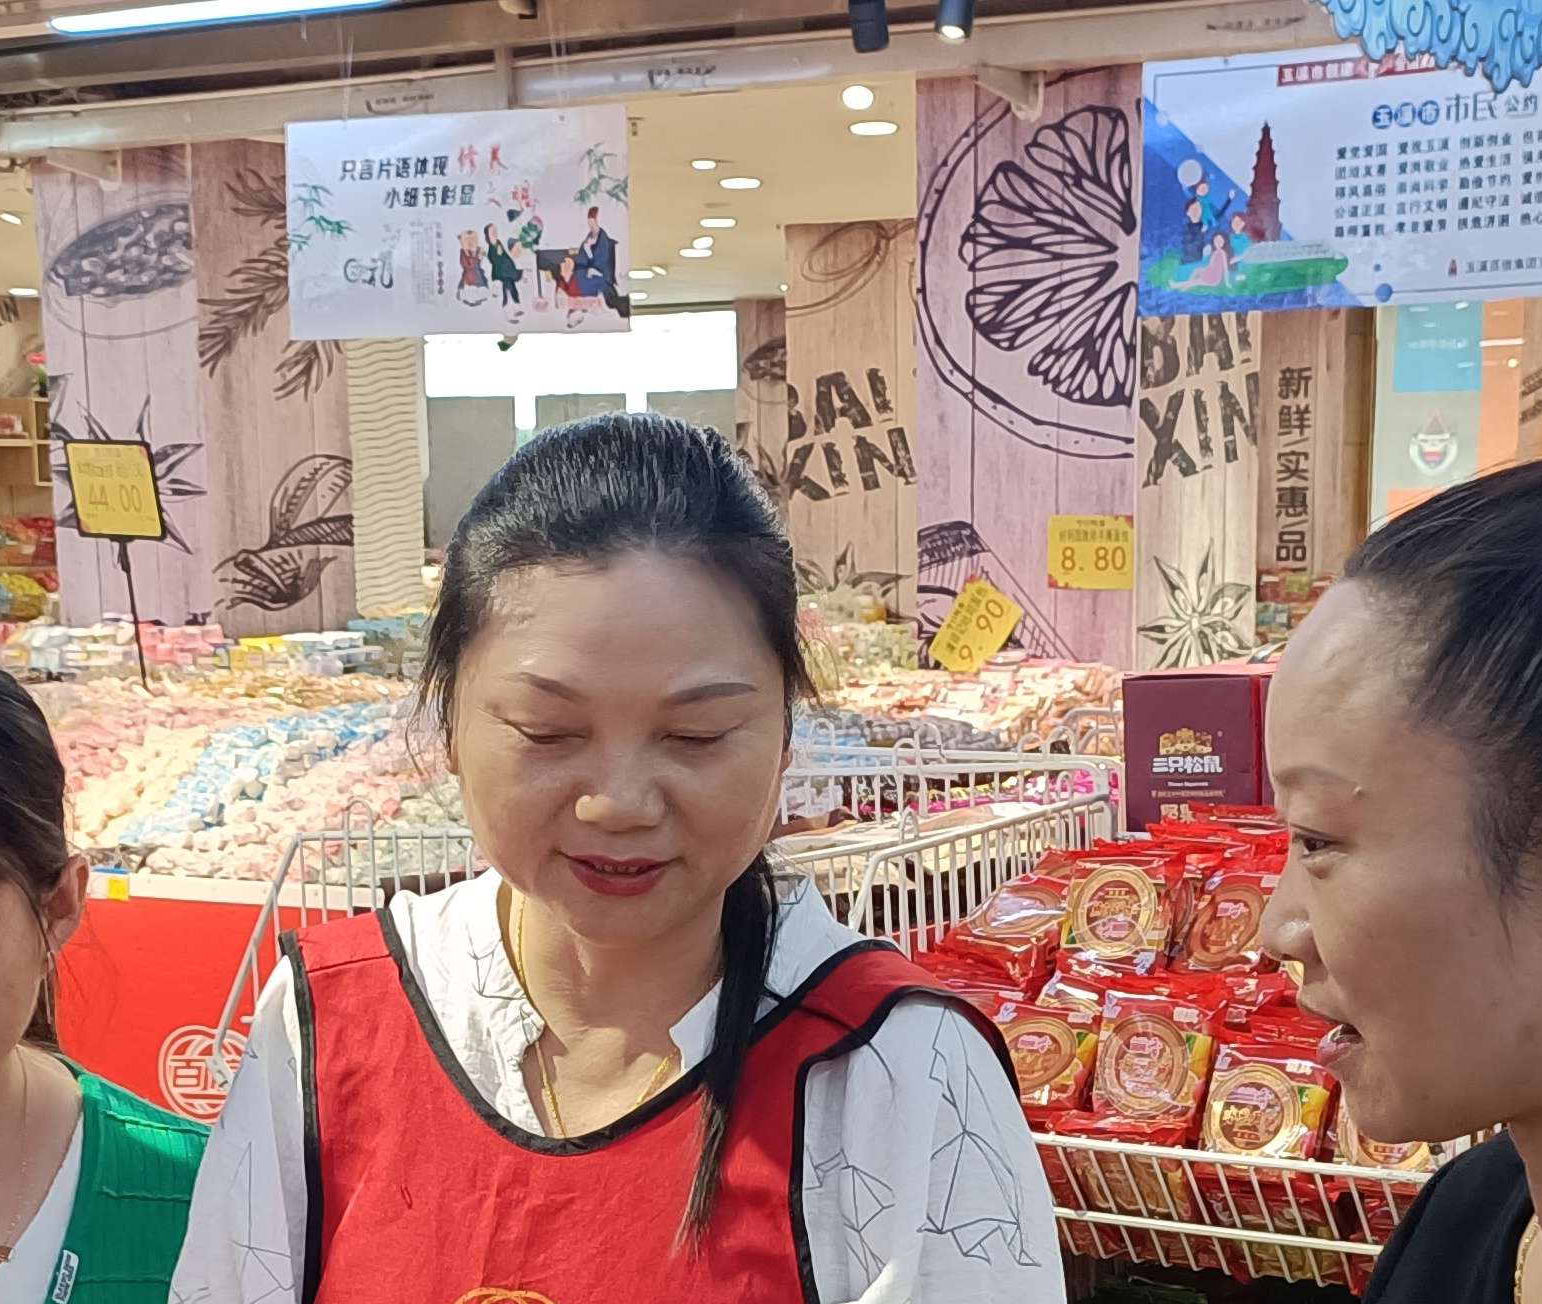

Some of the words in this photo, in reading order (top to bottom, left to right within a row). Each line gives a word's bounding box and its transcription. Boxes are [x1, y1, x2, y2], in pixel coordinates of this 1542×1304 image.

[339, 155, 449, 181] 只言片语体现
[1061, 546, 1126, 571] 8.80
[1151, 755, 1224, 774] 三只松鼠
